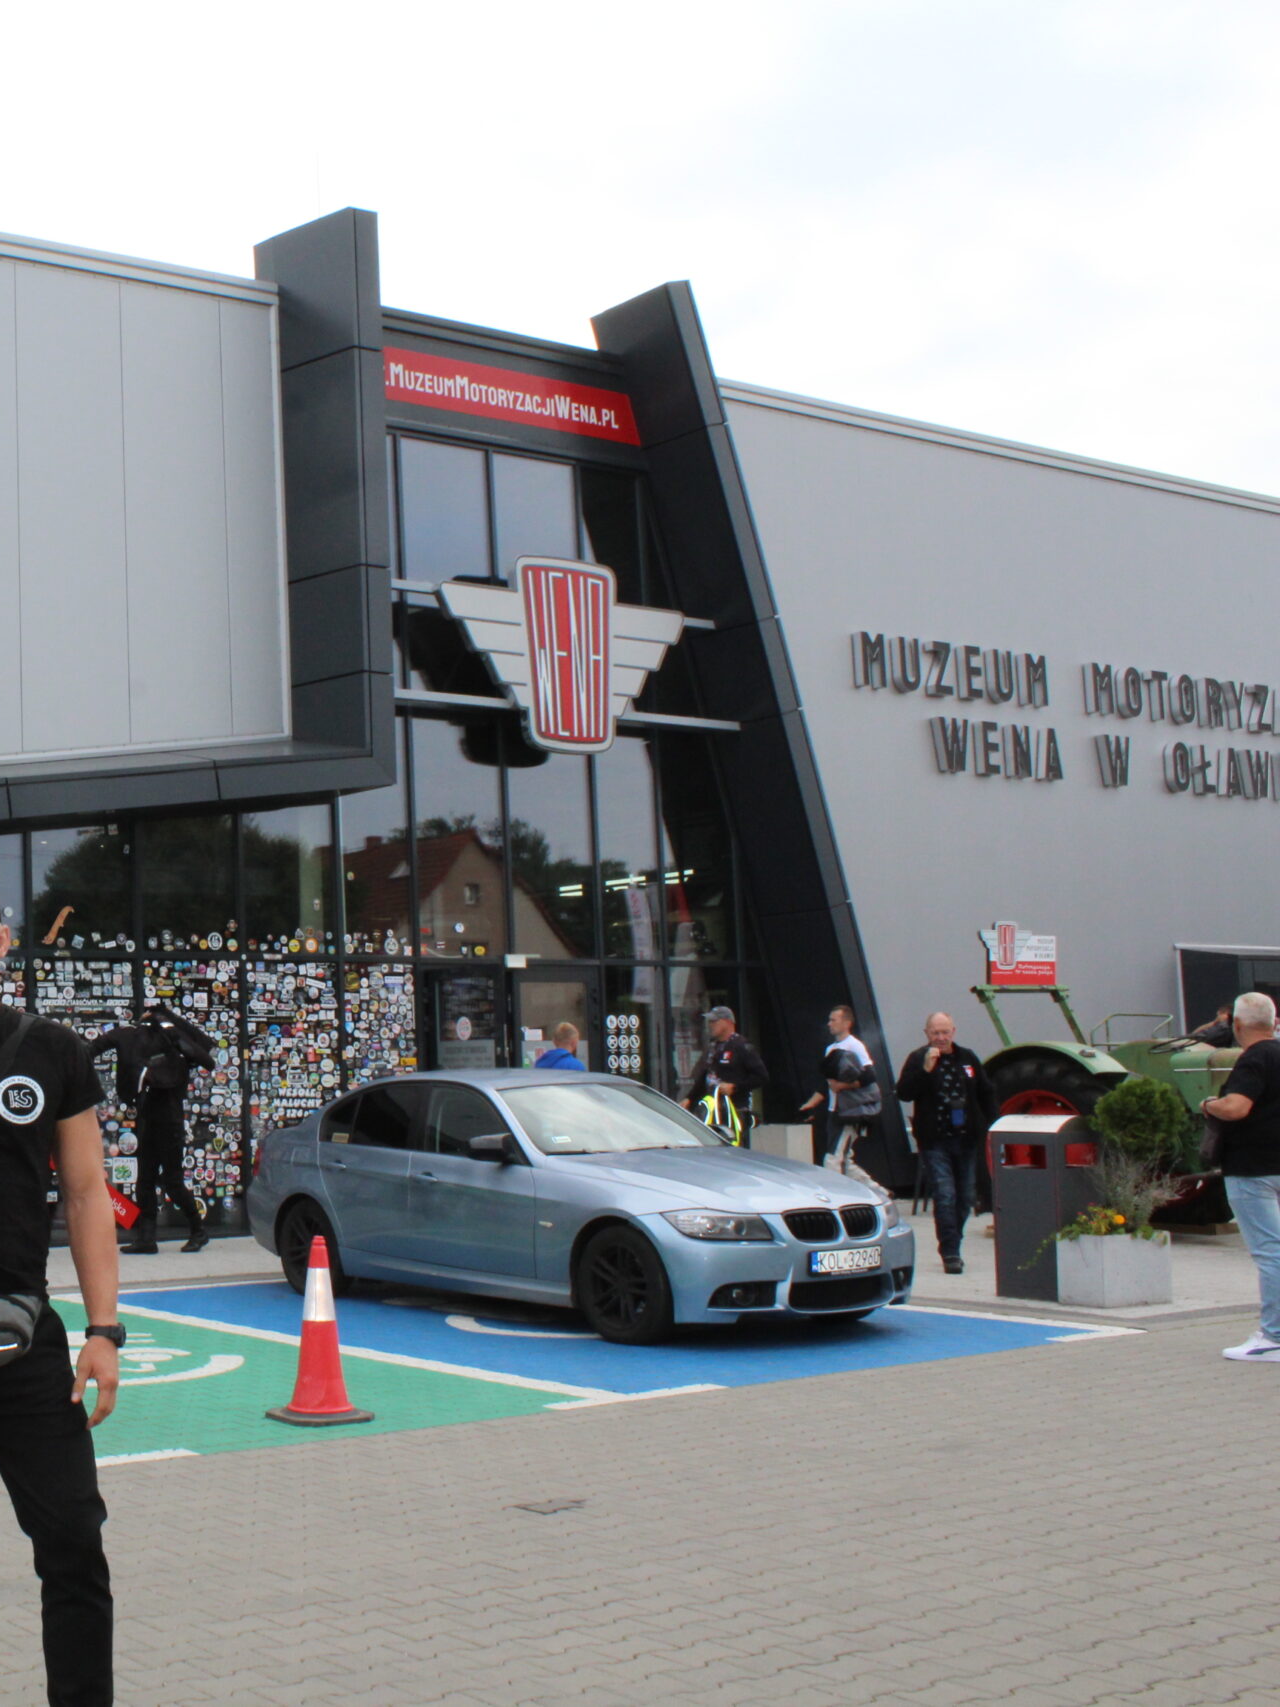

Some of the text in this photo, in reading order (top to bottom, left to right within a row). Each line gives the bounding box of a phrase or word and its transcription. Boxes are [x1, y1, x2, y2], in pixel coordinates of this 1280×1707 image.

[527, 569, 604, 738] WENA
[851, 631, 1280, 736] MUZEUM MOTORYZ
[930, 716, 1280, 801] WENA W OŁAW
[111, 1197, 127, 1216] lska
[819, 1248, 880, 1270] KOL 32960
